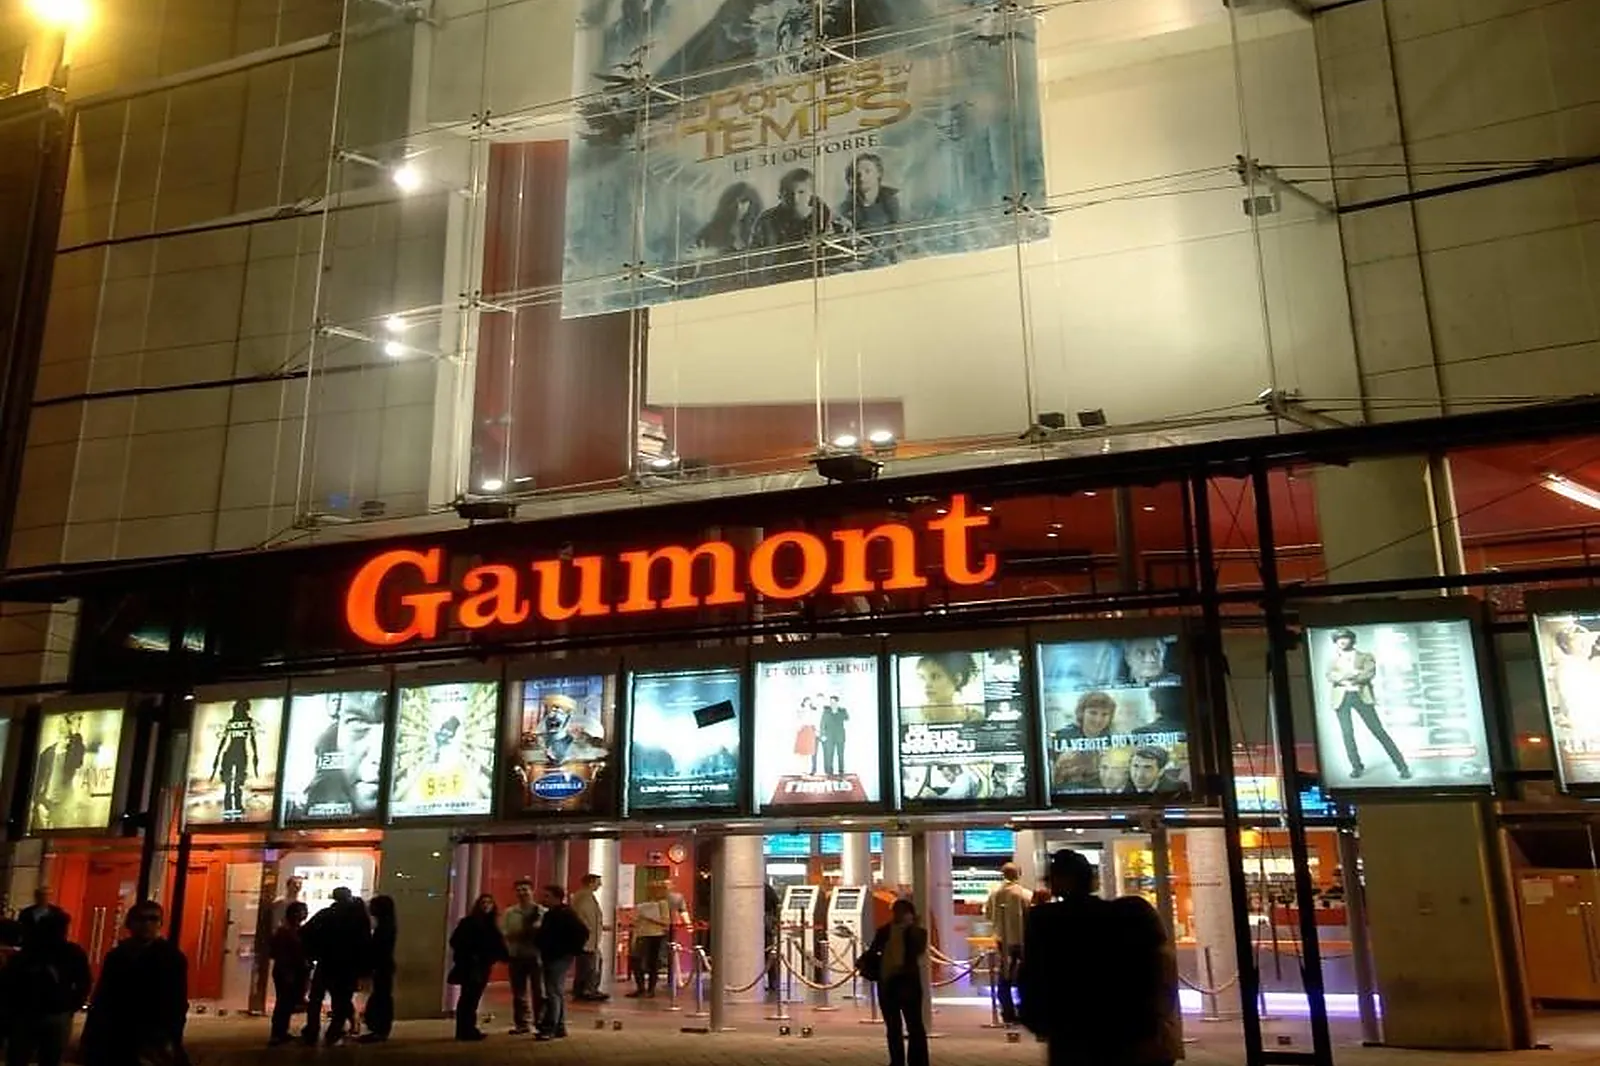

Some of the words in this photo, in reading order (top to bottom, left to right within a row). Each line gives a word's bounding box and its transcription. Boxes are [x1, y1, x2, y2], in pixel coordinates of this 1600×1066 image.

[709, 61, 885, 118] PORTES
[679, 81, 911, 163] TEMPS
[734, 159, 753, 173] LE
[759, 151, 777, 166] 31
[782, 133, 879, 163] OCTOBRE
[345, 493, 997, 647] Gaumont
[1055, 739, 1069, 752] LA
